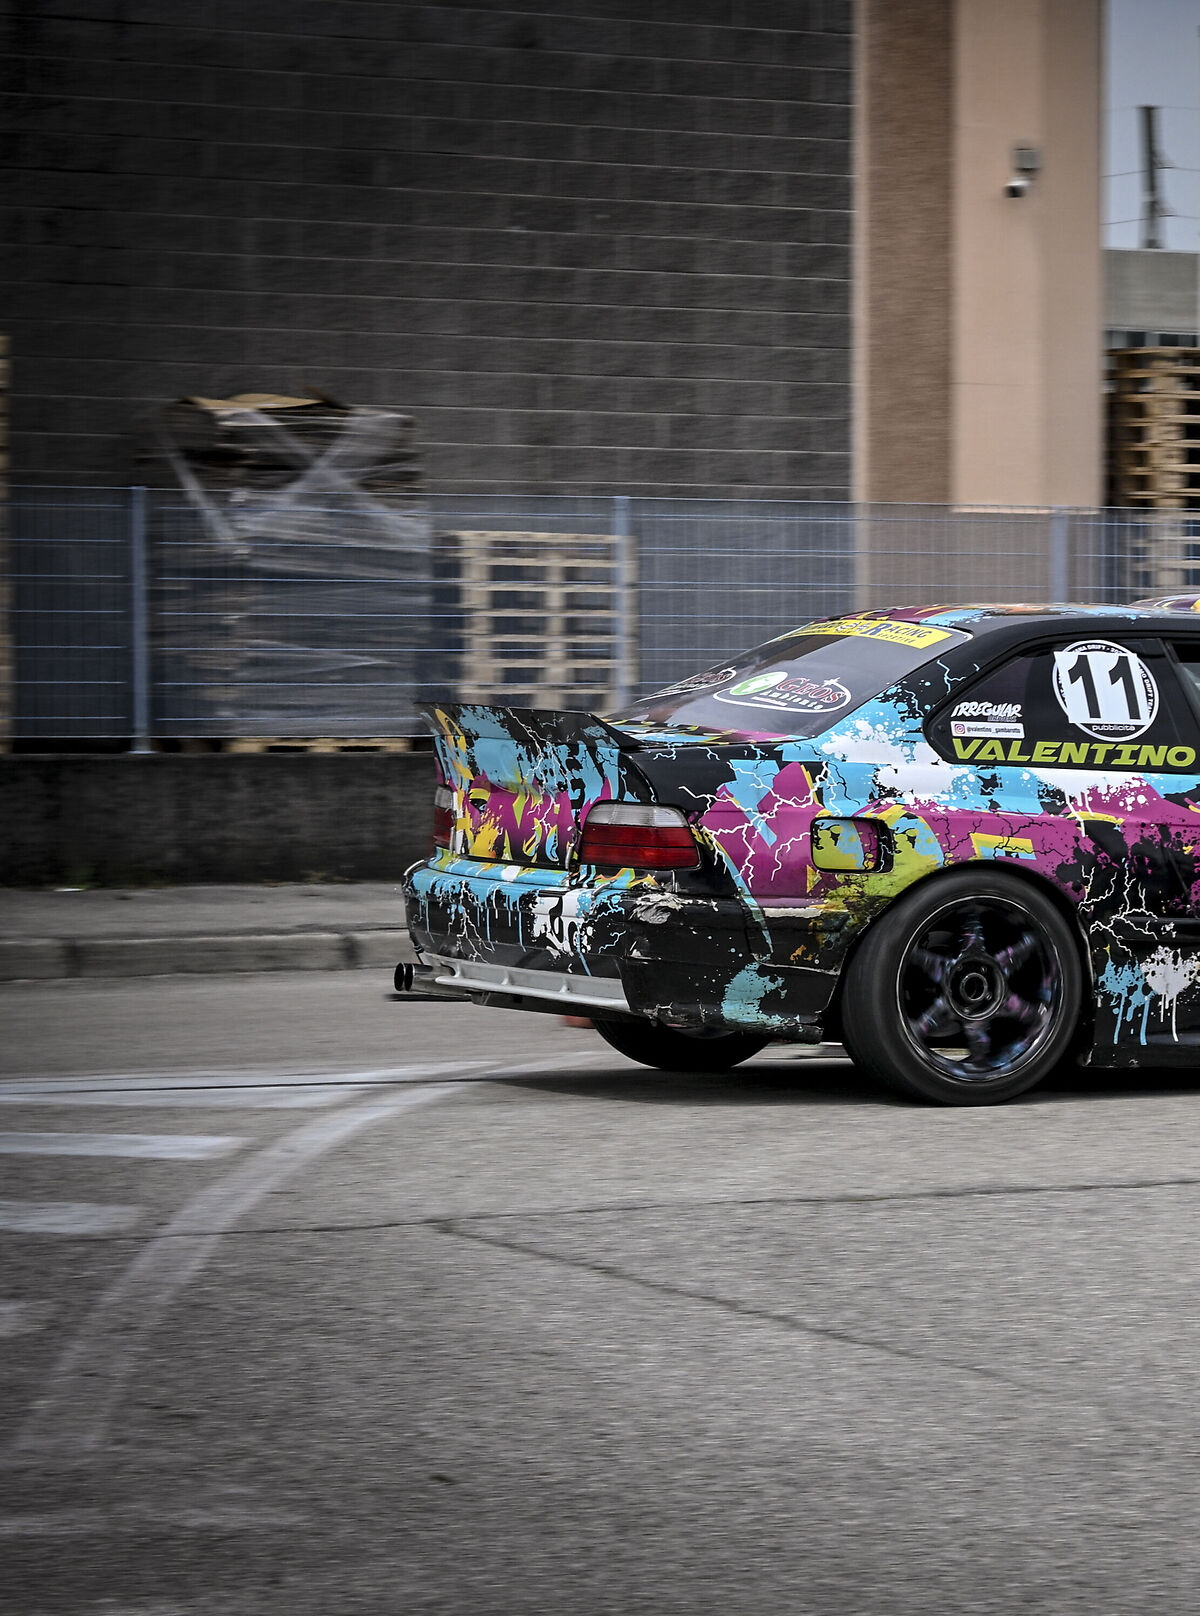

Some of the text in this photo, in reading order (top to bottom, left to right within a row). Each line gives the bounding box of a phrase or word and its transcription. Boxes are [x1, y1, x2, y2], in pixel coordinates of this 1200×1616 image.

[860, 623, 932, 638] RACING
[776, 677, 846, 703] GEOS
[1068, 655, 1141, 720] 11
[951, 701, 1022, 717] IRREGULAR
[952, 739, 1196, 767] VALENTINO
